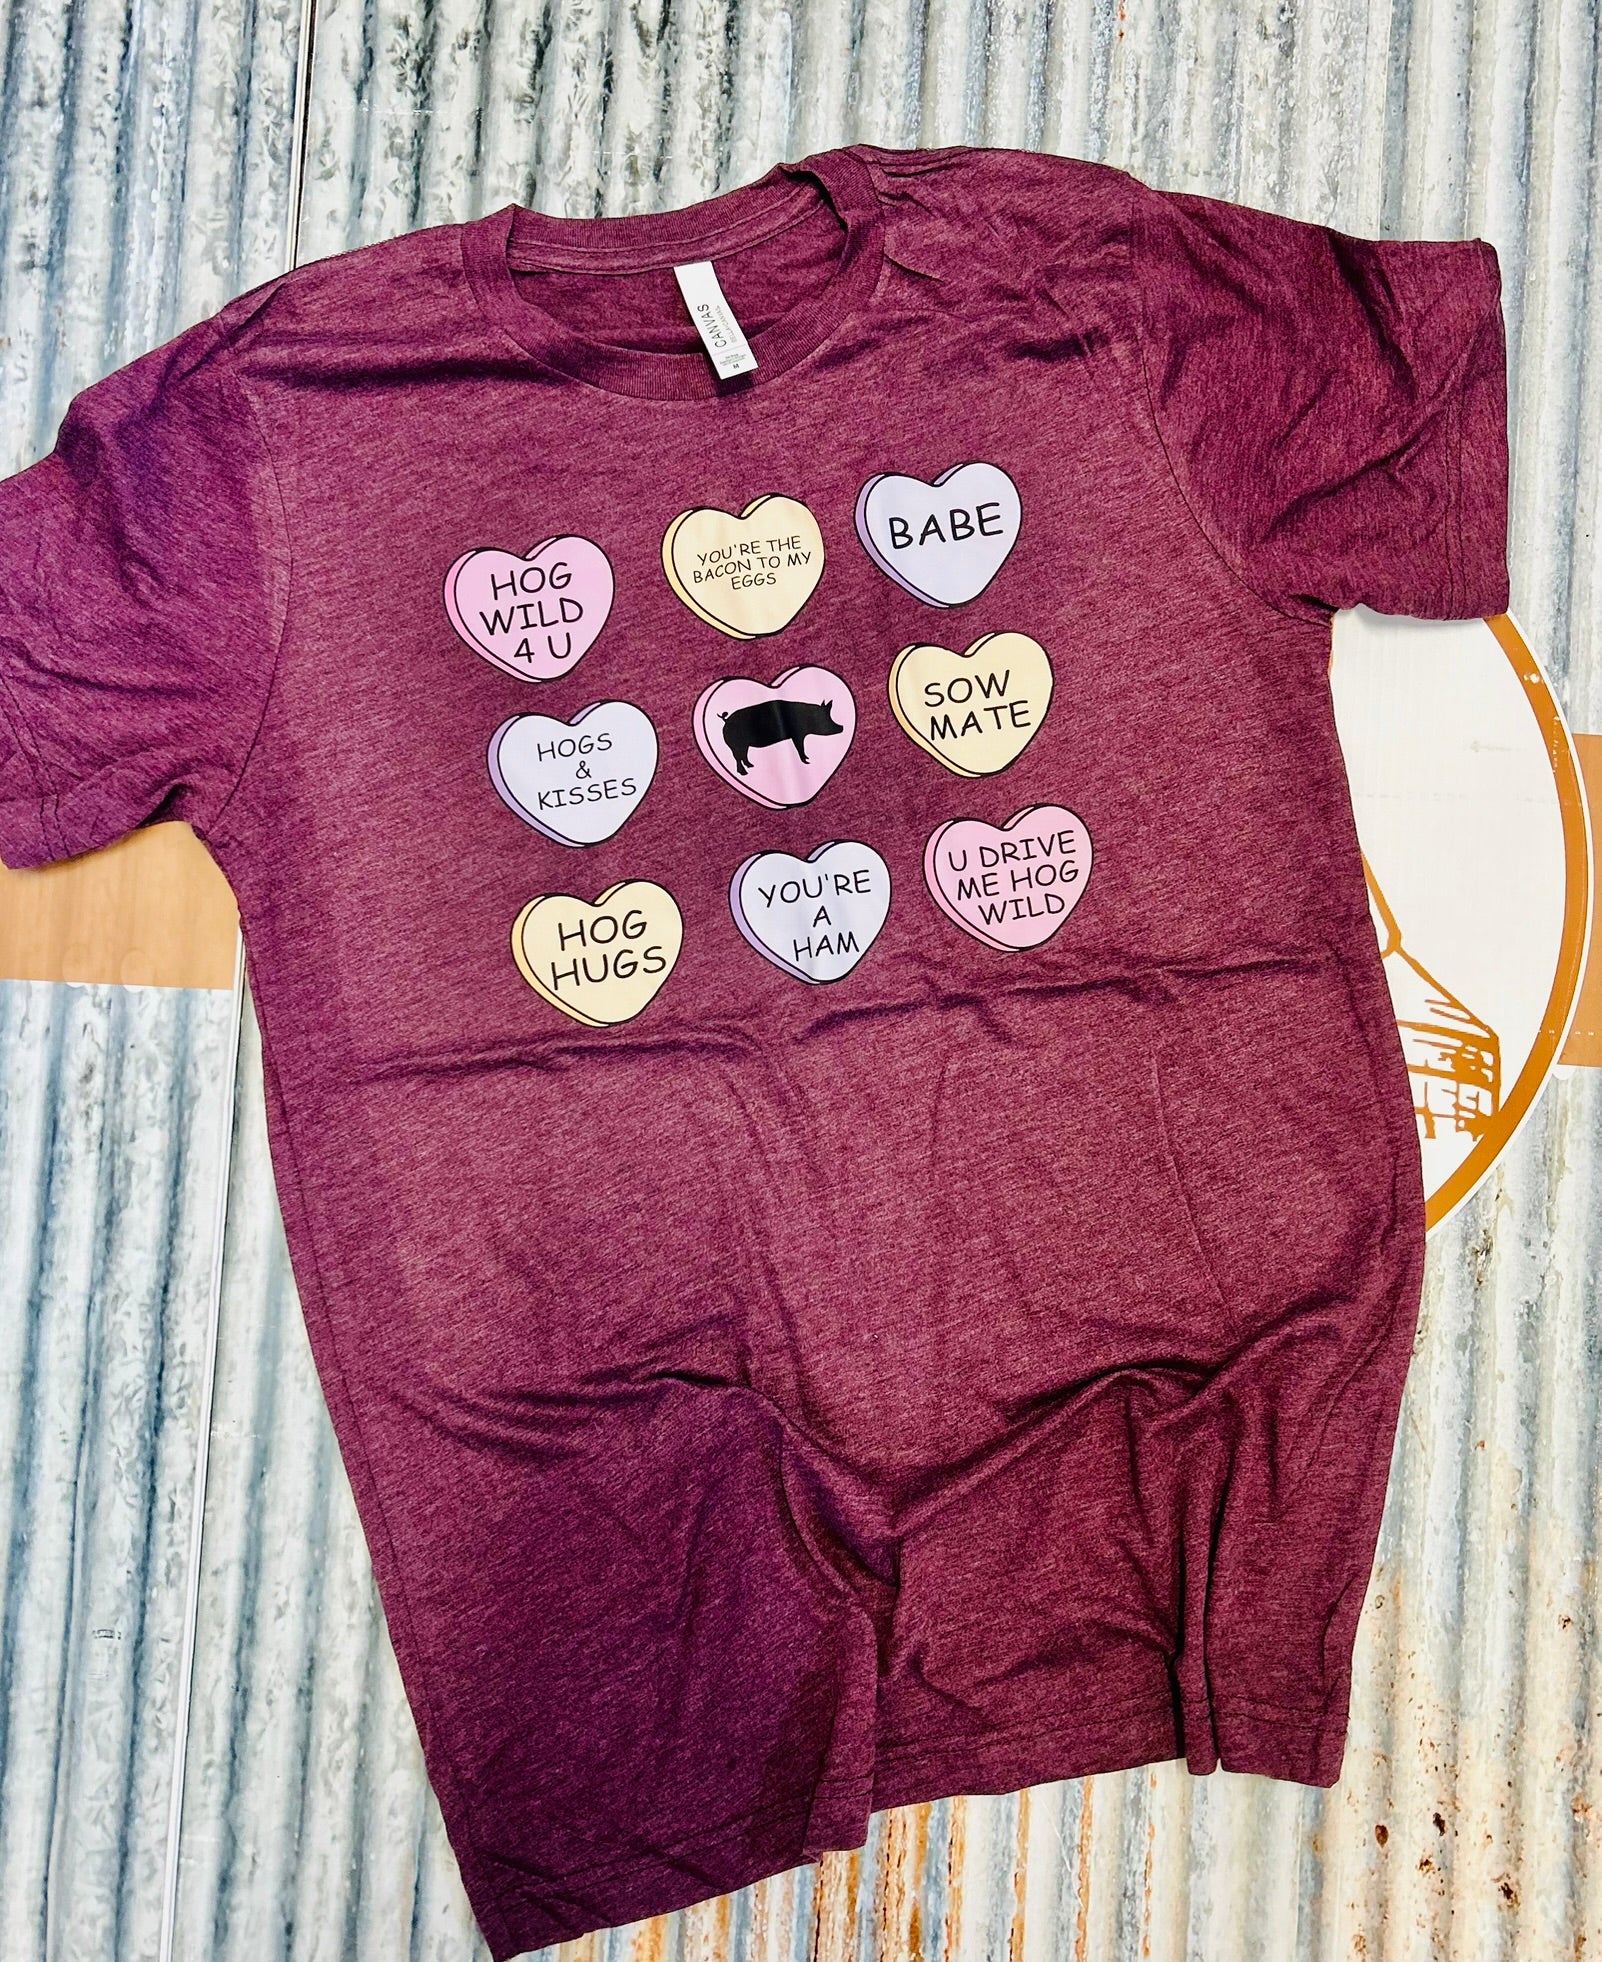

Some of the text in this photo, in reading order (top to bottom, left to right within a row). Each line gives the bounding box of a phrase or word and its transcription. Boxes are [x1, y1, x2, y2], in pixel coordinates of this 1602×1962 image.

[697, 303, 727, 348] CANVAS
[889, 503, 1003, 549] BABE
[694, 551, 812, 584] BACON TO MY
[697, 536, 801, 567] YOU'RE THE
[491, 562, 572, 600] HOG
[731, 573, 777, 590] EGGS
[479, 598, 584, 636] WILD
[513, 631, 572, 664] 4 U
[924, 670, 1010, 708] SOW
[930, 699, 1032, 741] MATE
[537, 733, 613, 762] HOGS
[575, 760, 592, 780] &
[538, 778, 637, 811] KISSES
[948, 830, 1076, 872] U DRIVE
[757, 869, 872, 909] YOU'RE
[957, 860, 1079, 901] ME HOG
[812, 905, 832, 928] A
[978, 893, 1066, 926] WILD
[558, 909, 648, 952] HOG
[793, 931, 860, 962] HAM
[550, 946, 667, 991] HUGS
